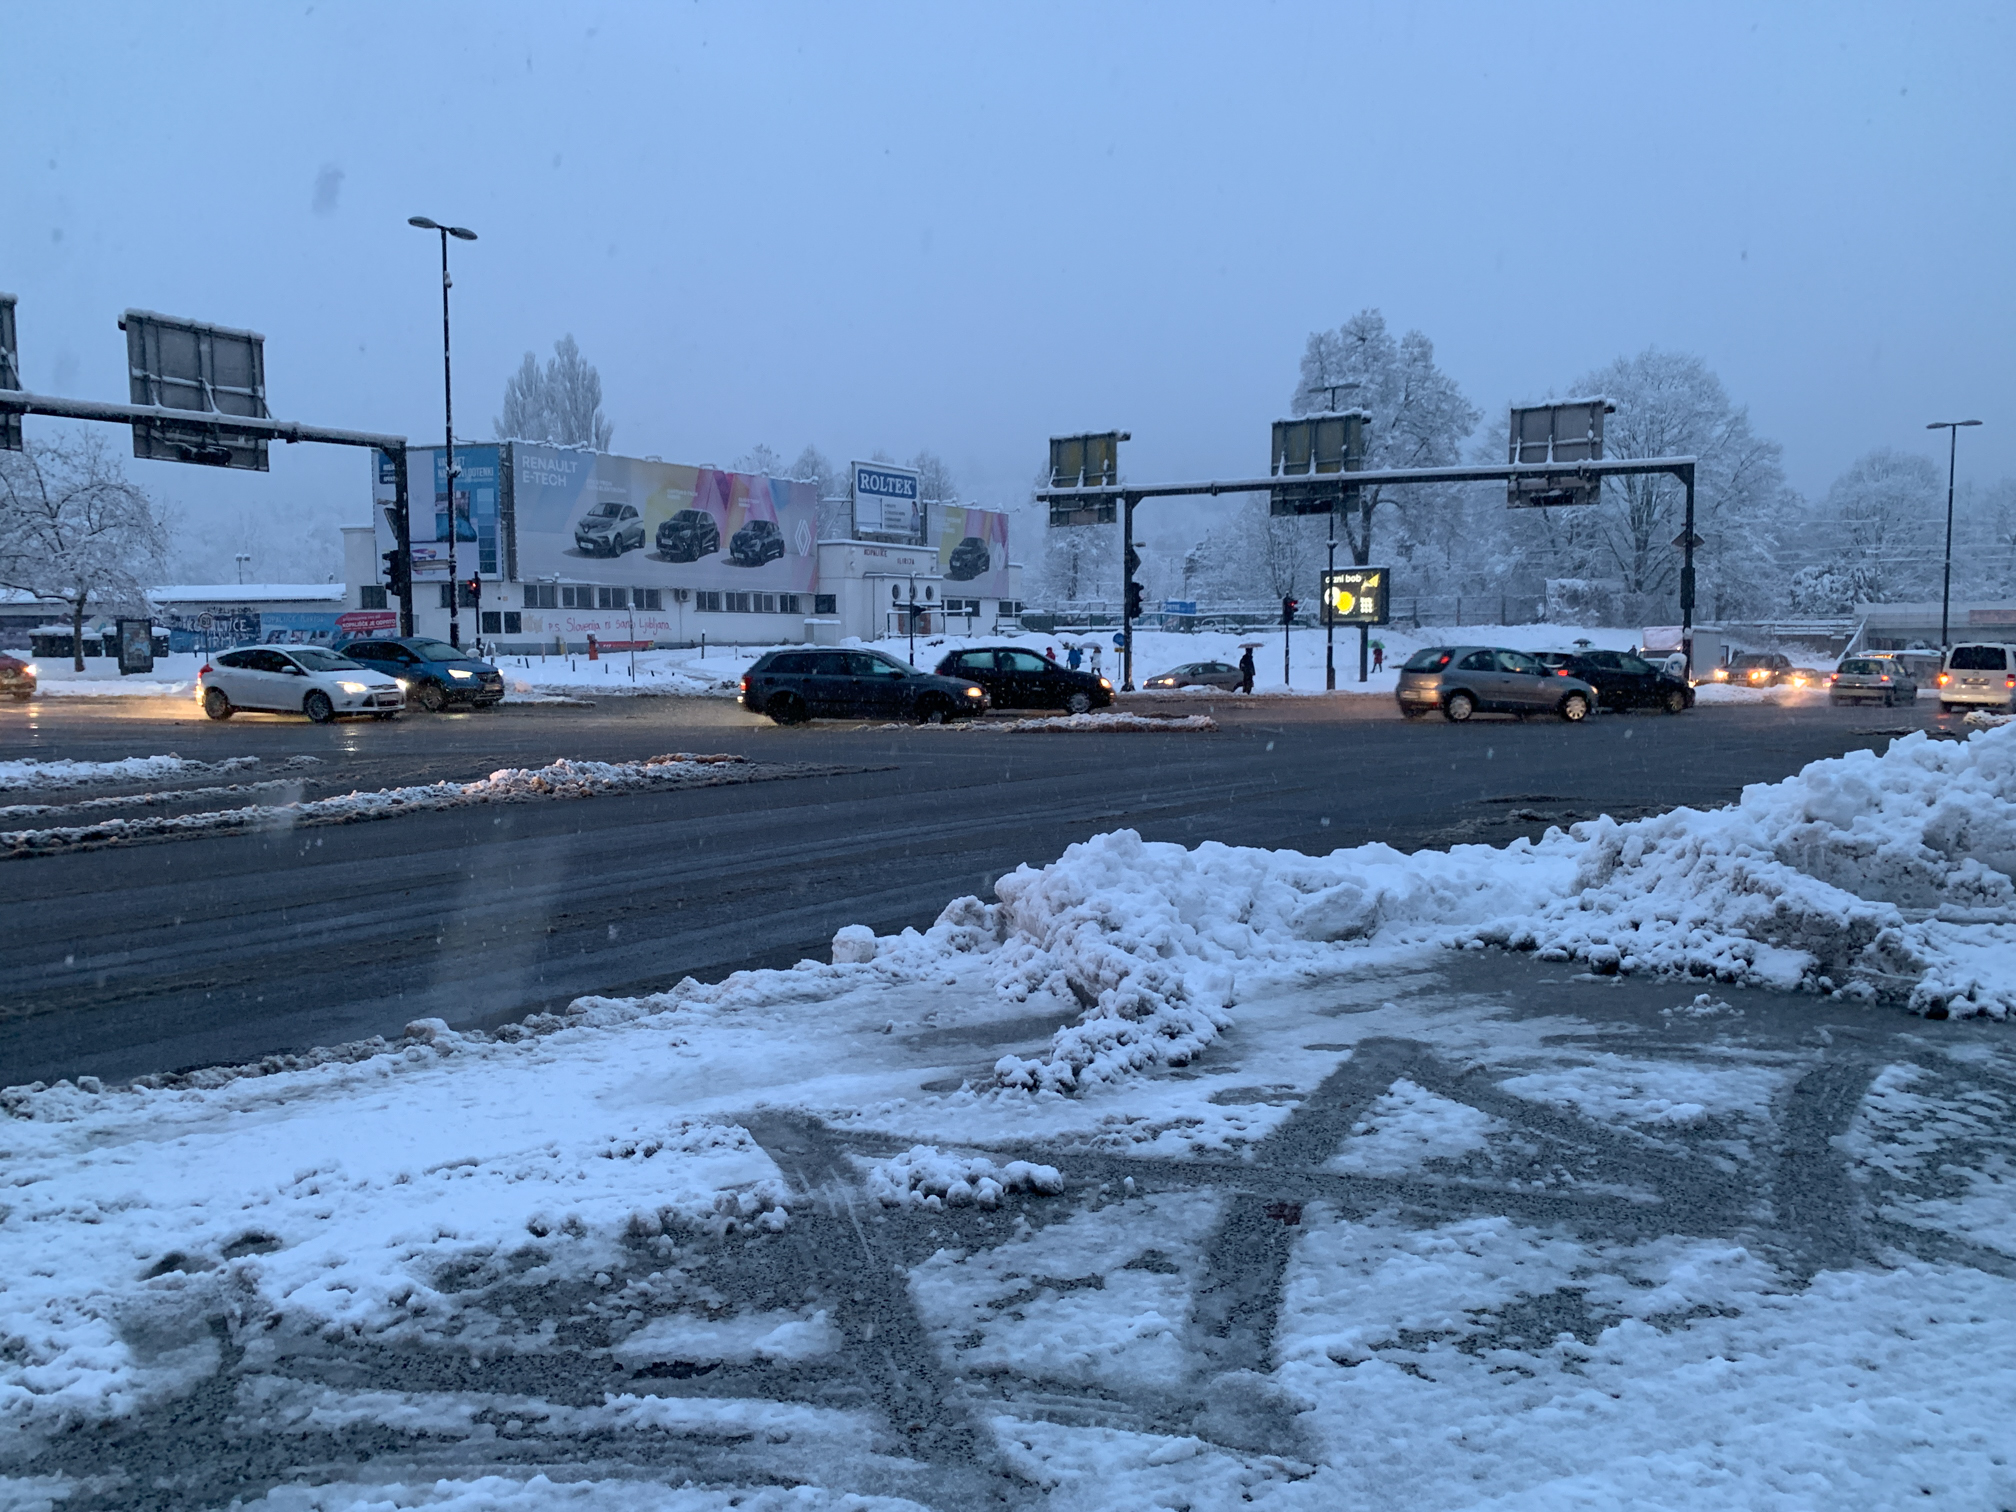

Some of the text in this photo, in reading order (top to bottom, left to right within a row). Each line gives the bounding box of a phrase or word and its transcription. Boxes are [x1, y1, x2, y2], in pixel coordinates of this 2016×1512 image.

[522, 456, 577, 474] RENAULT
[522, 471, 567, 487] E-TECH
[860, 473, 913, 495] ROLTEK
[1345, 574, 1362, 583] bob
[201, 617, 211, 625] 60
[376, 618, 396, 626] ODPRTO
